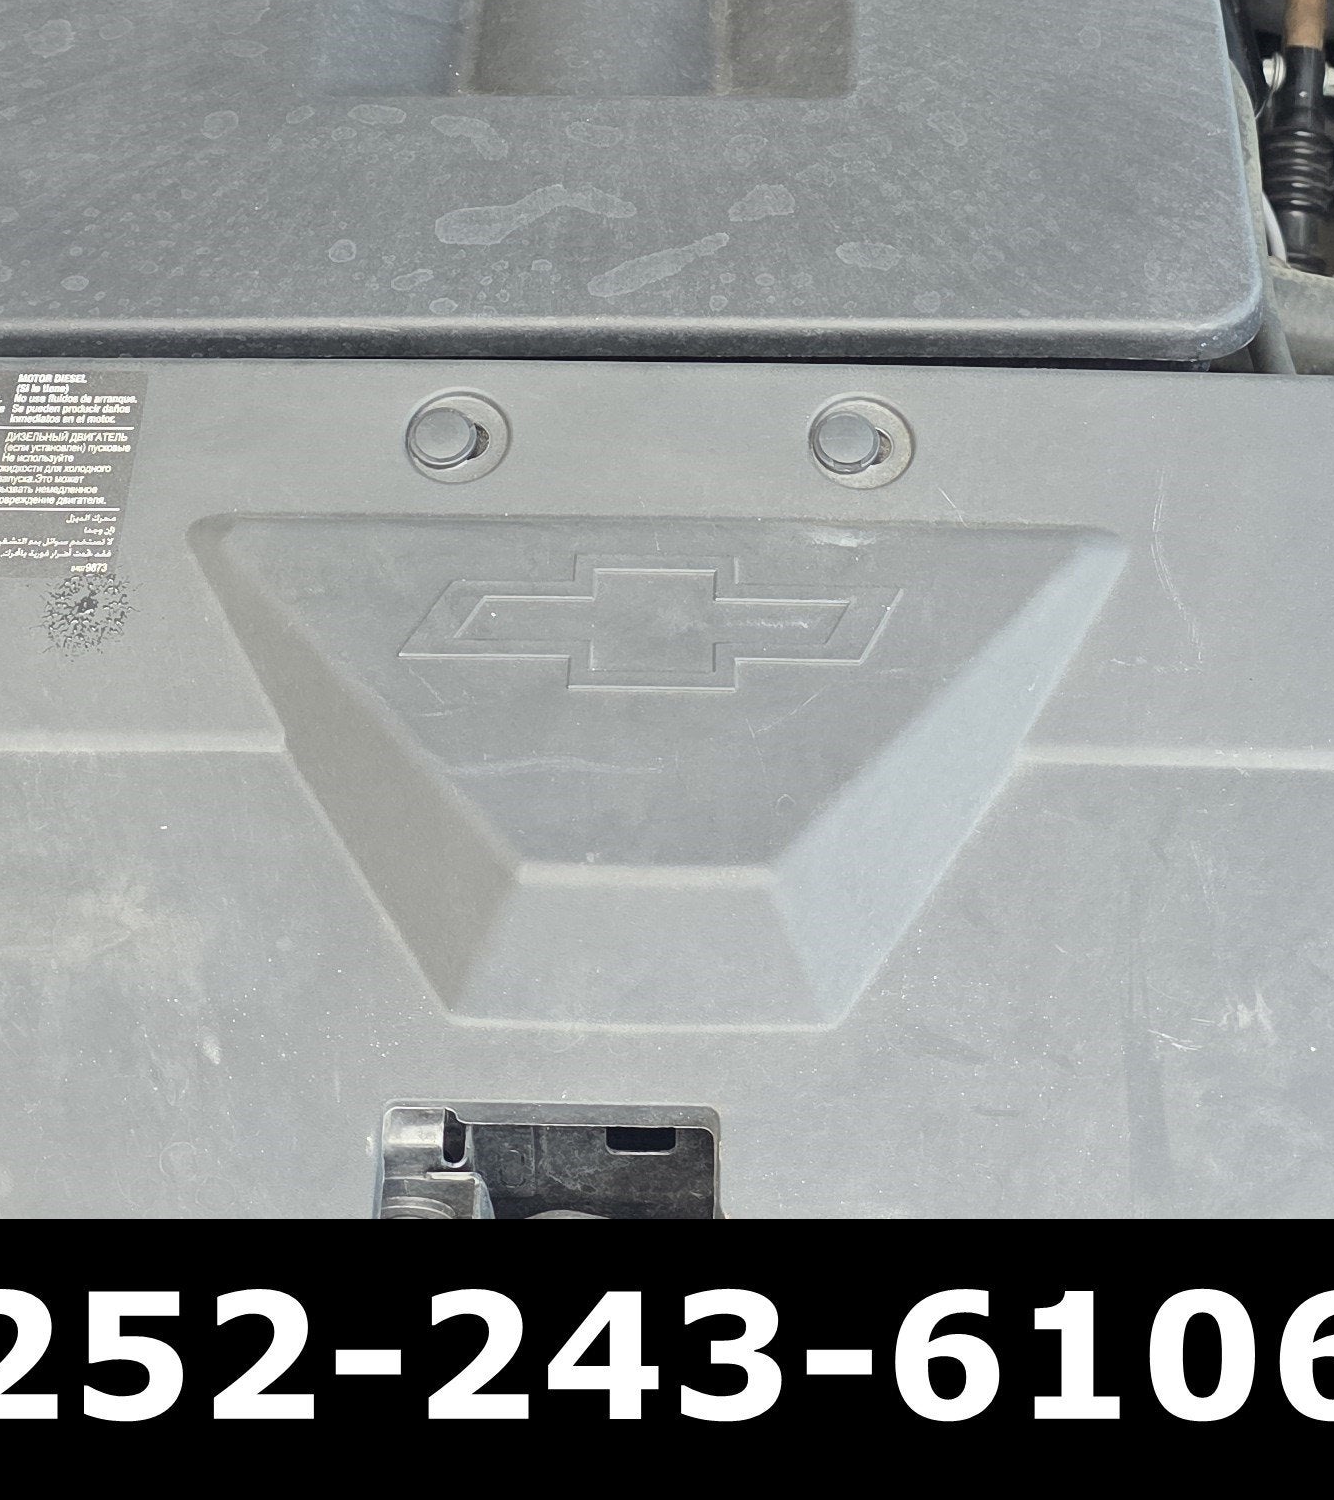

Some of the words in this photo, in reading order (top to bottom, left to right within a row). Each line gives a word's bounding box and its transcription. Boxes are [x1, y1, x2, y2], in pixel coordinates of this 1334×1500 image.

[17, 373, 53, 383] MOTOR
[53, 373, 87, 383] DIESEL
[16, 384, 30, 394] (Si
[13, 393, 27, 403] No
[47, 394, 79, 403] fluidos
[79, 394, 92, 403] de
[93, 395, 138, 405] arranque.
[11, 404, 25, 413] Se
[26, 404, 61, 414] pueden
[62, 404, 101, 414] producir
[62, 415, 75, 423] en
[75, 414, 86, 423] el
[86, 414, 116, 424] motor.
[5, 431, 69, 442] ДИЗЕЛЬНЫЙ
[69, 432, 128, 442] ДВИГАТЕЛЬ
[30, 444, 86, 454] установлен)
[2, 453, 15, 462] Не
[16, 453, 75, 464] используйте
[43, 465, 63, 474] для
[63, 464, 112, 474] холодного
[54, 475, 85, 484] может
